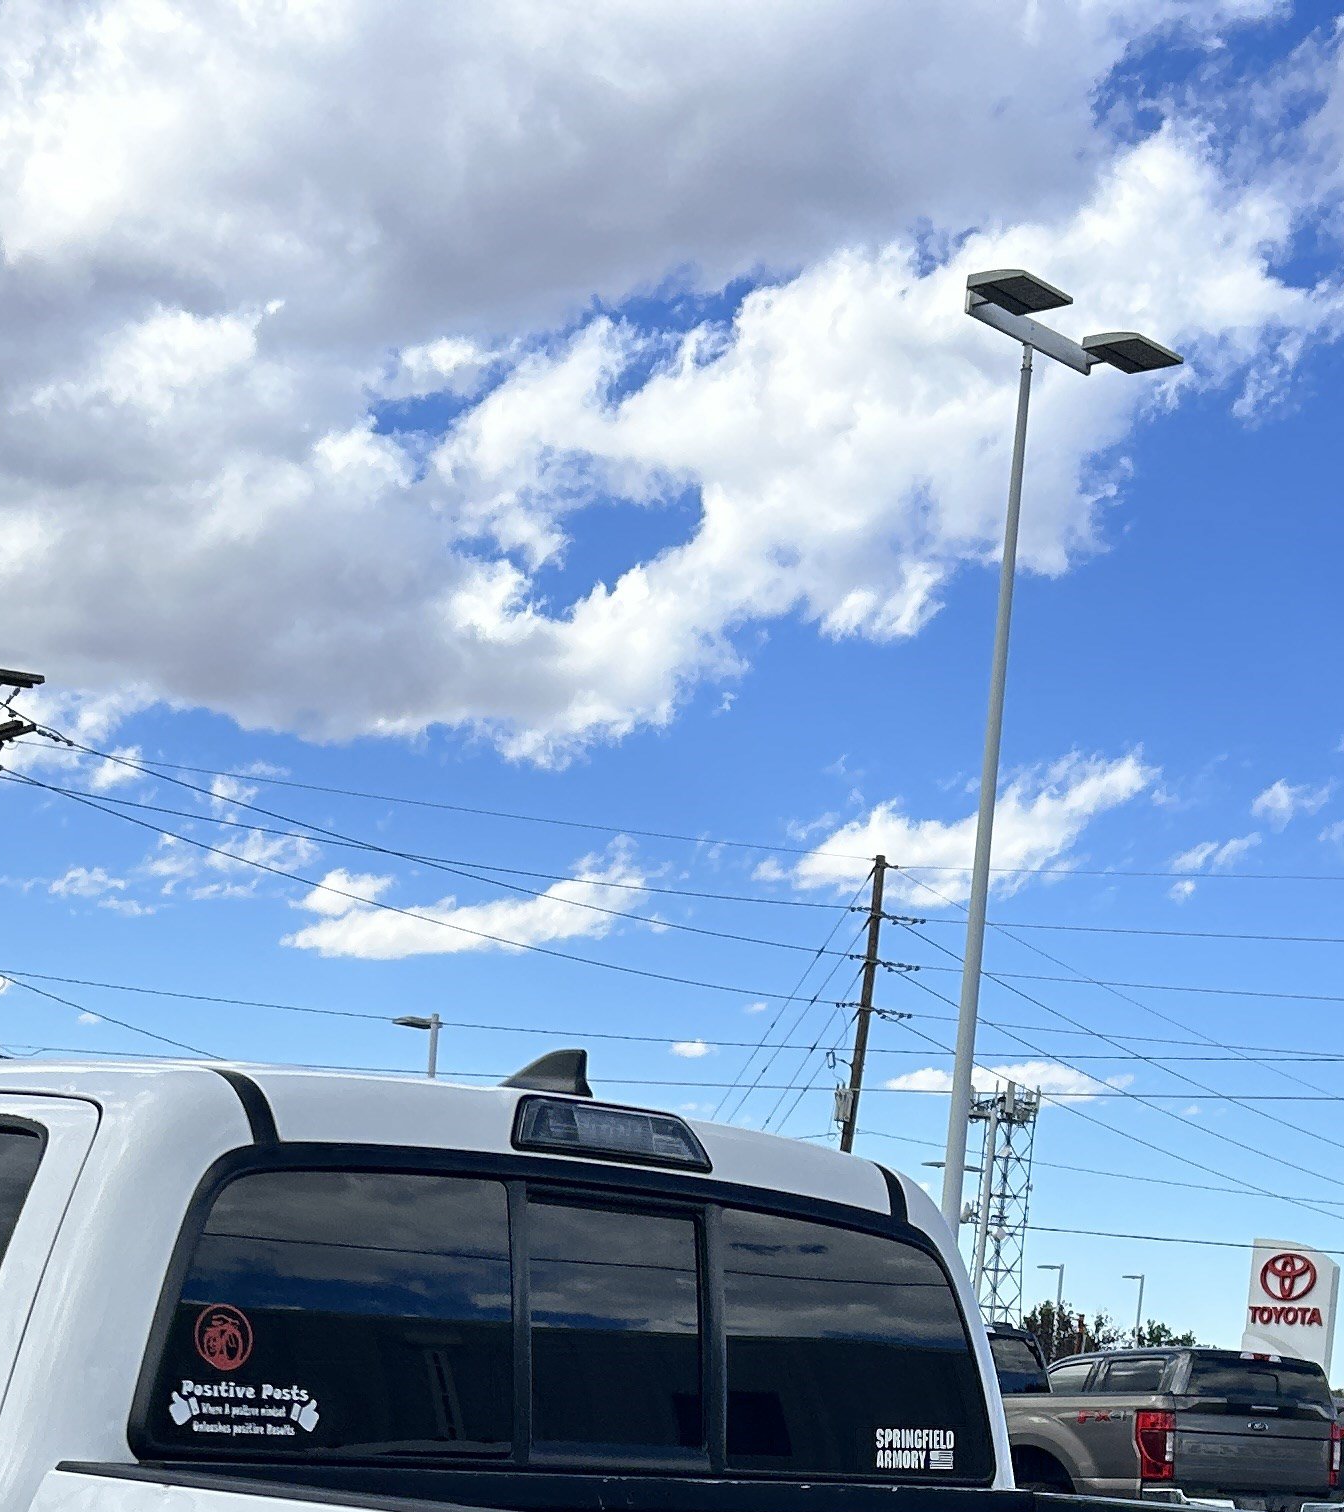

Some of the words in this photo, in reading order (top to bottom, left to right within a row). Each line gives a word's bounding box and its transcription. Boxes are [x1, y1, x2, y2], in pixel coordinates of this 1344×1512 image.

[1248, 1305, 1323, 1326] TOYOTA
[181, 1379, 256, 1399] Positive
[261, 1383, 309, 1401] Posts
[875, 1428, 955, 1449] SPRINGFIELD
[876, 1449, 927, 1469] ARMORY
